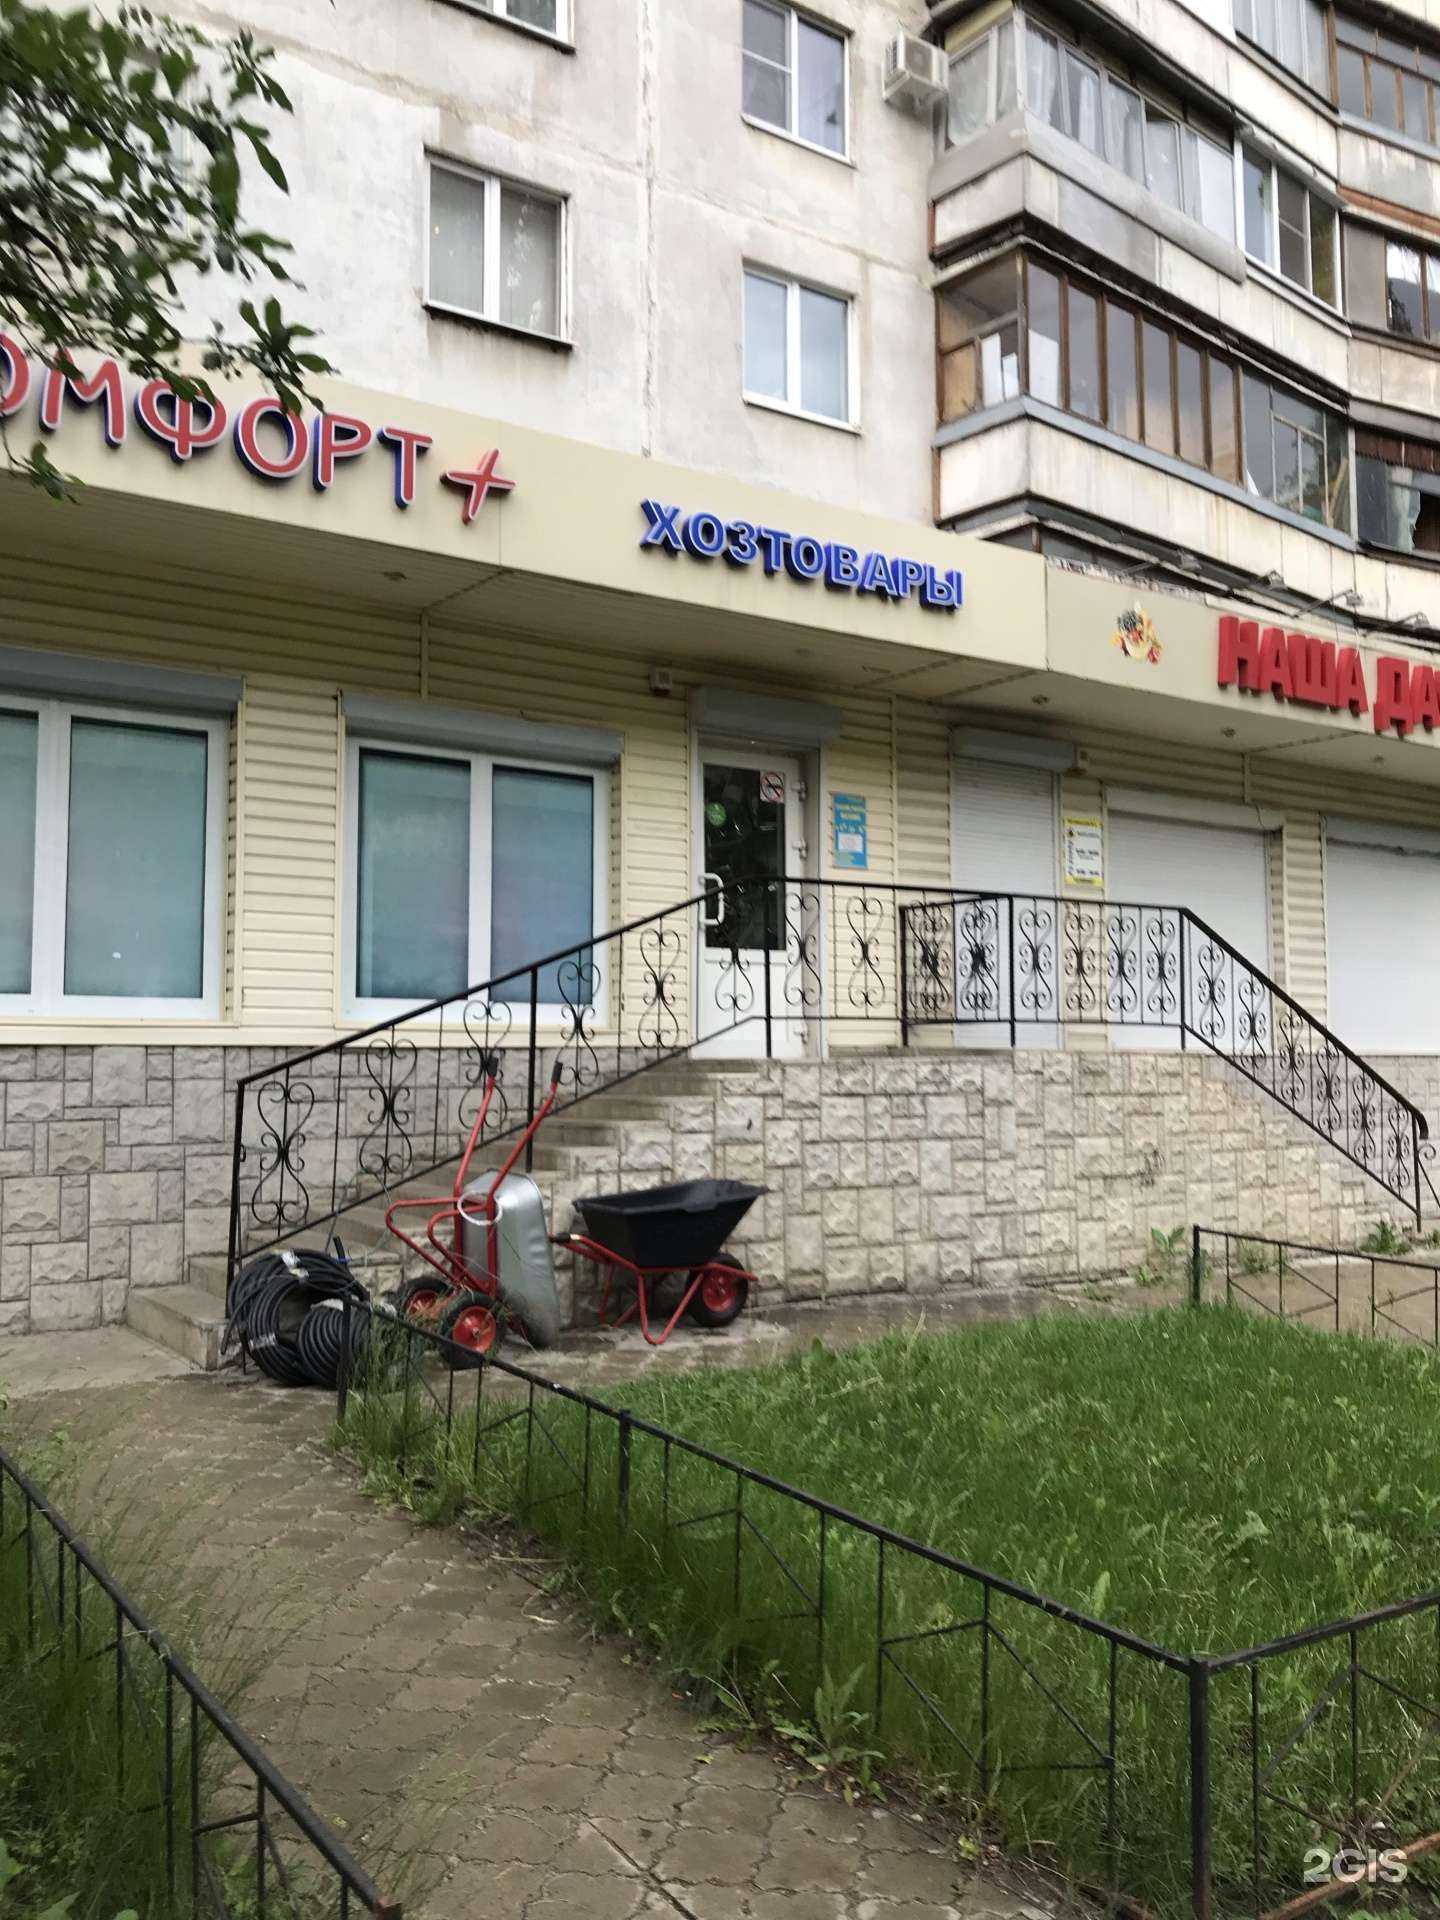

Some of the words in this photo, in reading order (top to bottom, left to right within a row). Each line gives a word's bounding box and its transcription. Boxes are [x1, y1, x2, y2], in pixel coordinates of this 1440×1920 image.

[640, 497, 965, 613] ХОЗТОВАРЫ
[1217, 615, 1369, 716] НАША
[1373, 656, 1440, 737] ДА
